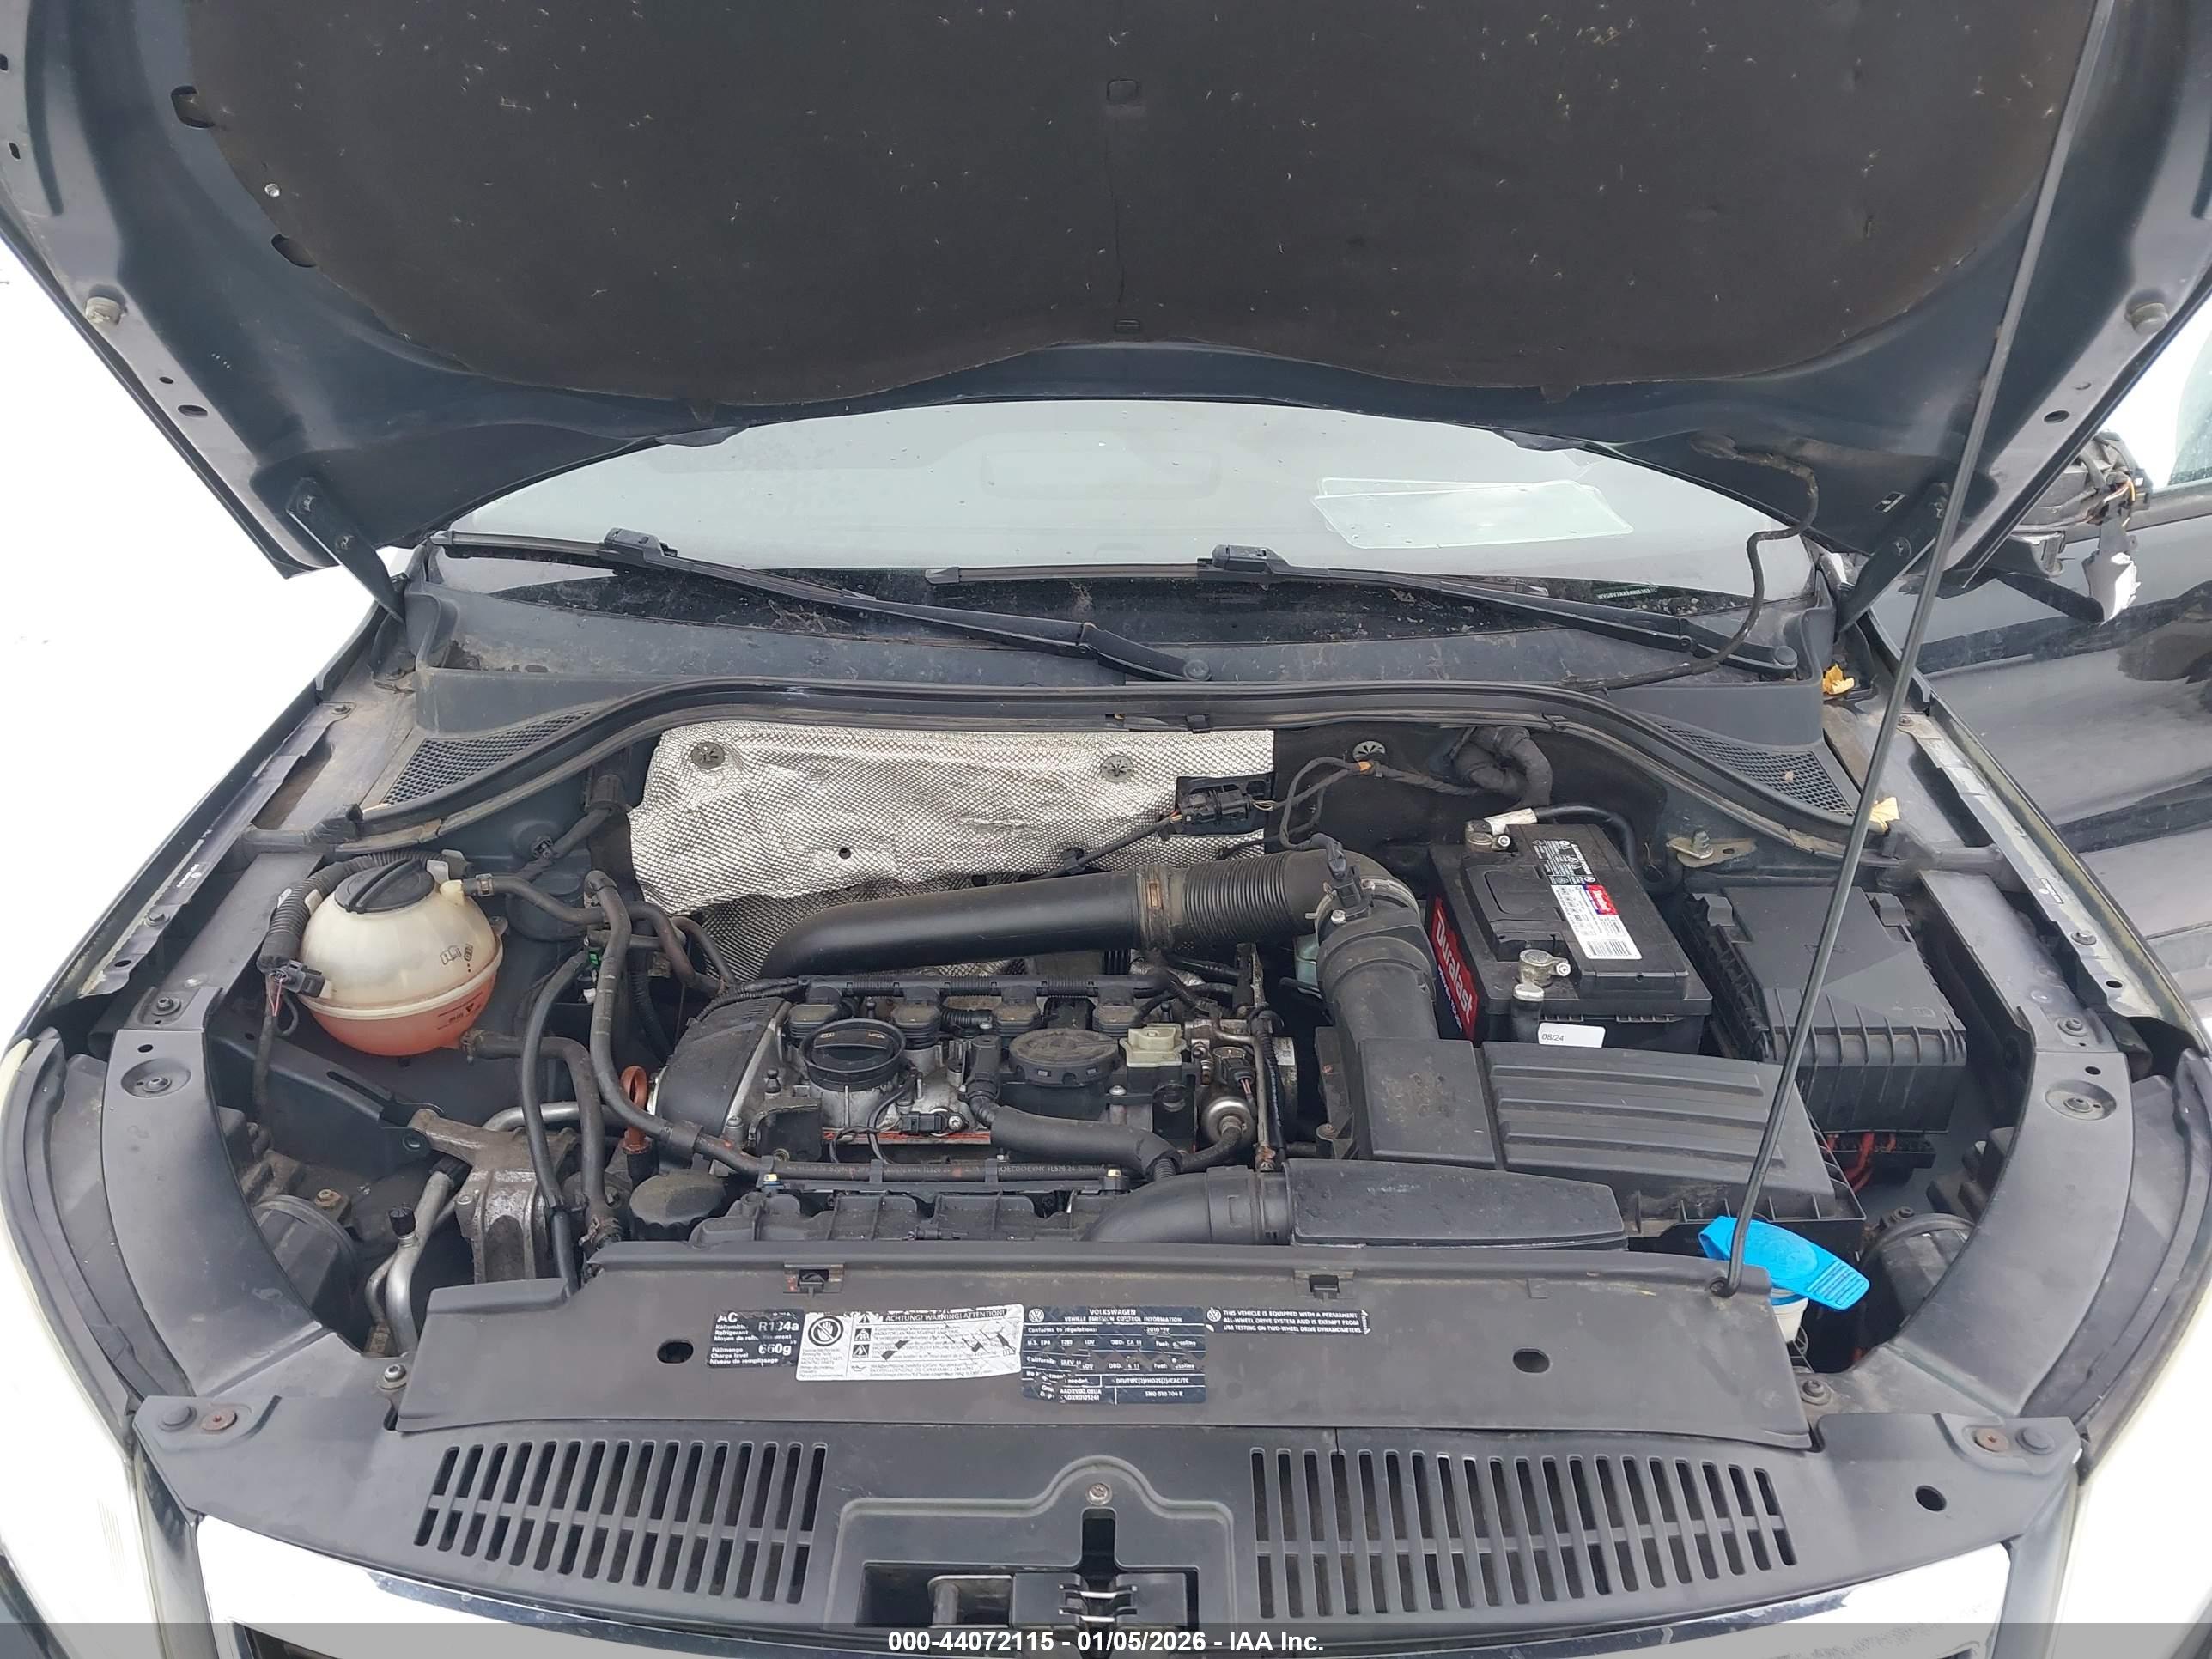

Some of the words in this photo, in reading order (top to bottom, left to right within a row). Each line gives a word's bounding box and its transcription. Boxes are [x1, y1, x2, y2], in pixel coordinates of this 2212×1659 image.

[1436, 908, 1473, 1024] Duralast
[717, 1311, 738, 1323] AC
[885, 1314, 924, 1322] ACHTUNG!
[925, 1311, 963, 1322] WARNING!
[963, 1310, 1006, 1320] ATTENTION!
[758, 1321, 800, 1332] R134a
[714, 1329, 749, 1338] Refrigerant
[758, 1343, 792, 1356] 660g
